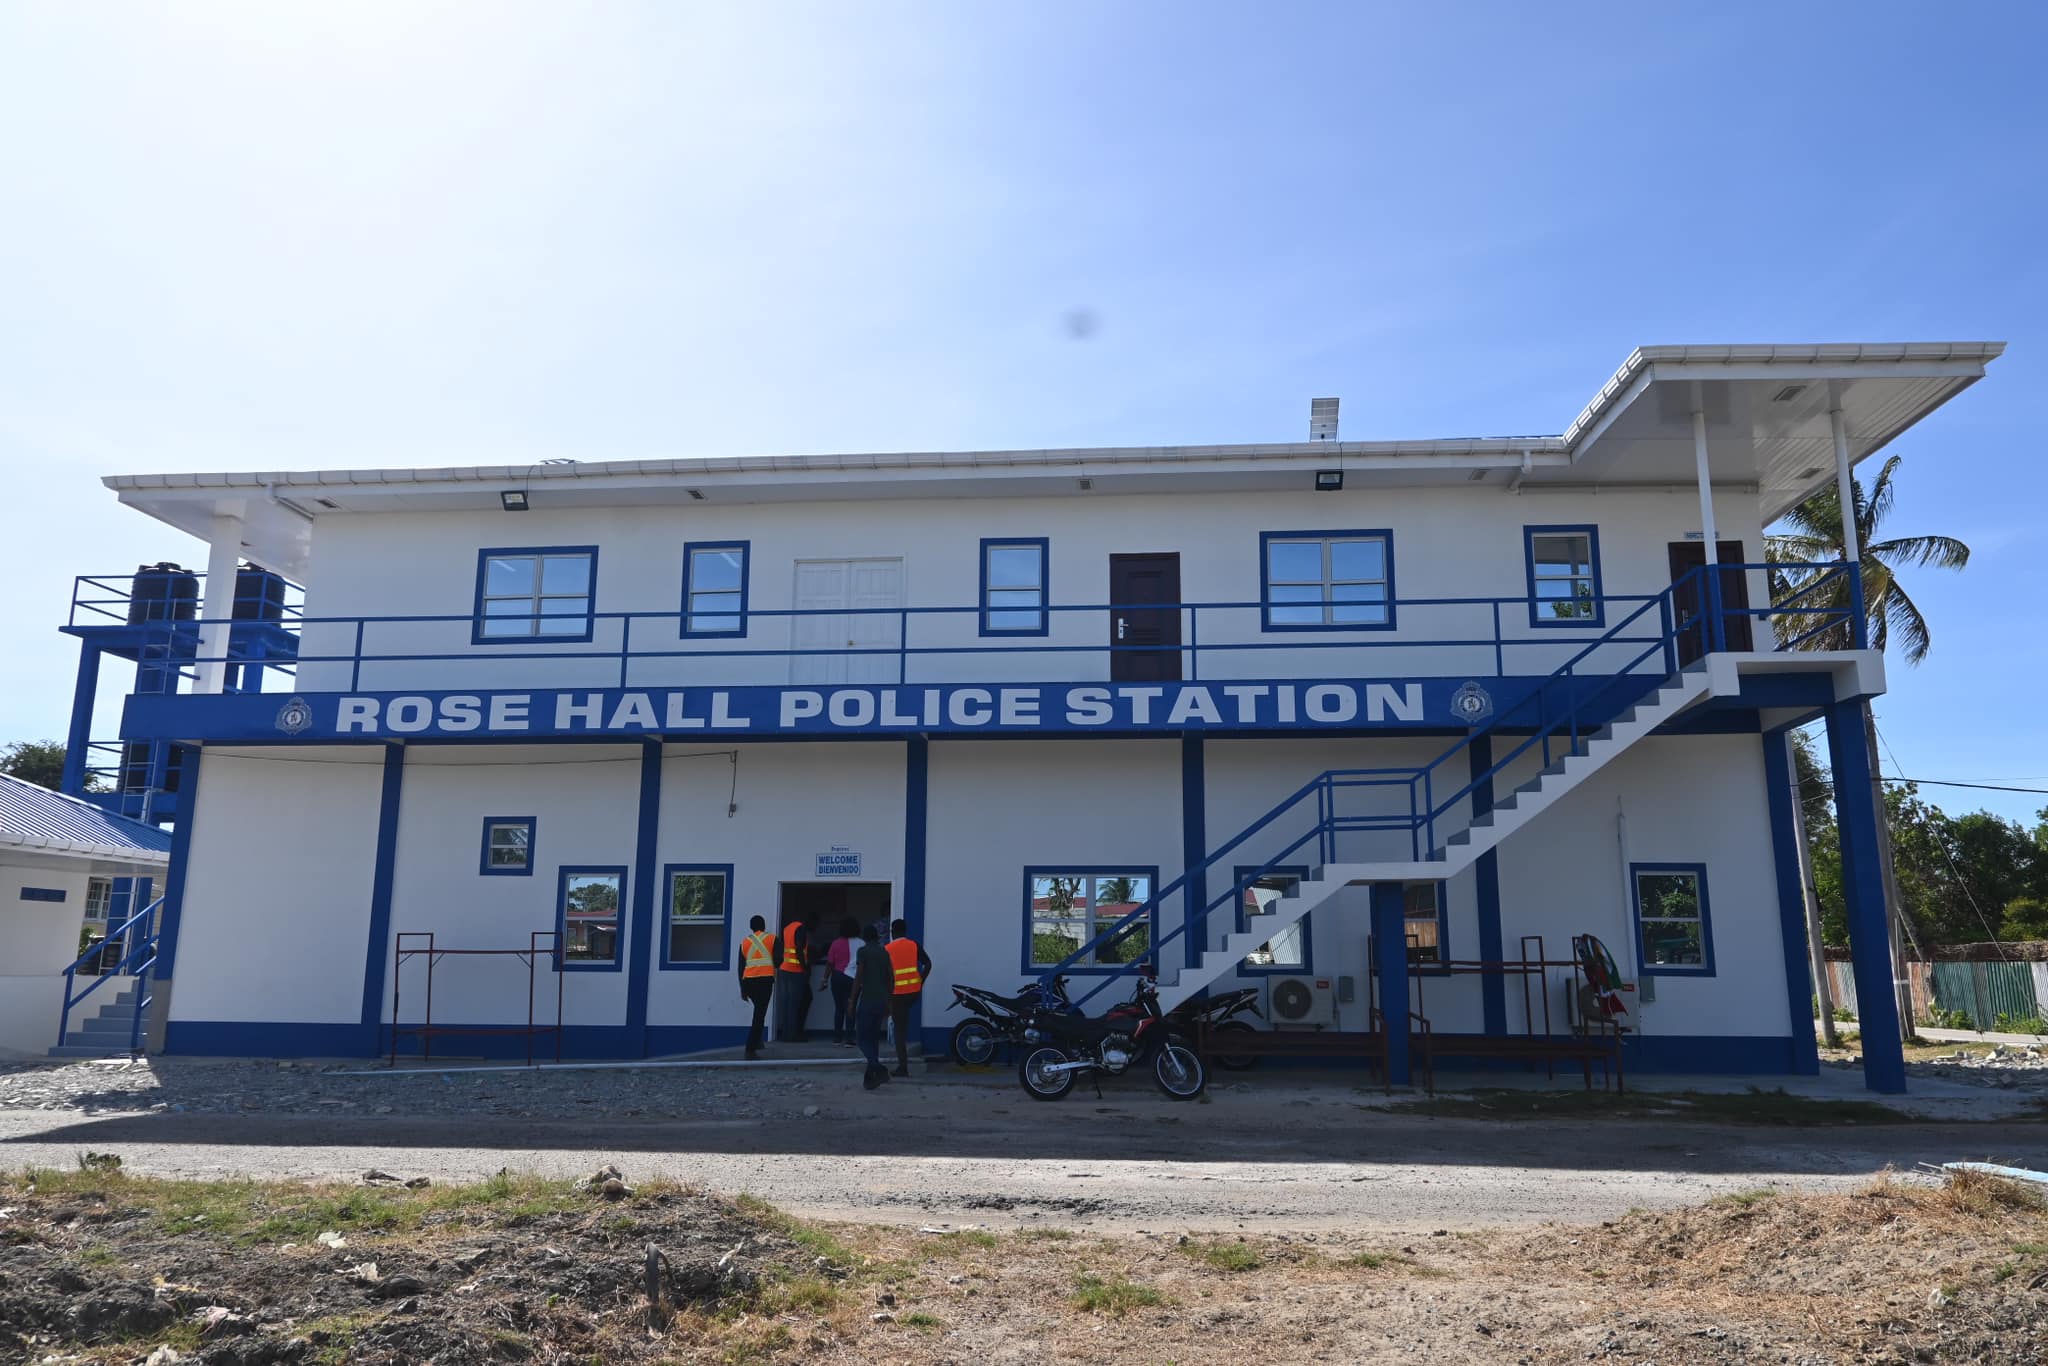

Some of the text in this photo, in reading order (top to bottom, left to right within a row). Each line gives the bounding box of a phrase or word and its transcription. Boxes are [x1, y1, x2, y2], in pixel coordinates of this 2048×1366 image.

[335, 694, 531, 733] ROSE
[554, 693, 751, 730] HALL
[779, 688, 1041, 728] POLICE
[1065, 684, 1424, 725] STATION
[818, 855, 858, 864] WELCOME
[818, 865, 859, 874] BIENVENIDO
